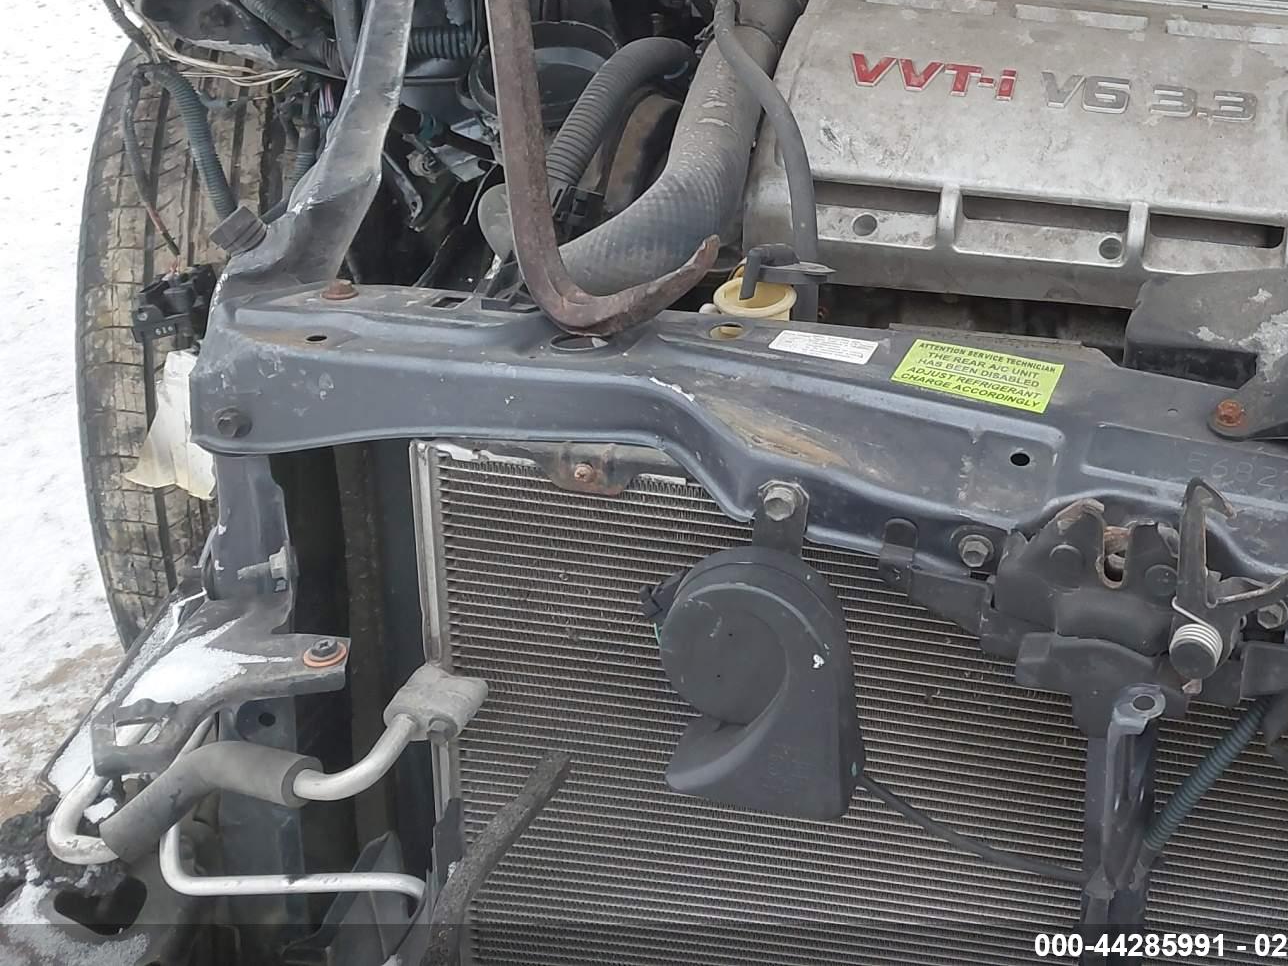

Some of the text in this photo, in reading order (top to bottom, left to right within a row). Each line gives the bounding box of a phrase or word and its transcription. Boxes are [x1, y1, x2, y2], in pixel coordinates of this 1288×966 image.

[851, 51, 1018, 101] VVT-i
[1041, 70, 1258, 122] V6 3.3
[918, 342, 1056, 373] ATTENTION SERVICE TECHNICIAN
[918, 358, 1040, 388] HAS BEEN DISABLED
[927, 352, 1039, 378] THE REAR A/C UNIT
[900, 373, 1041, 408] CHARGE ACCORDINGLY
[906, 366, 1042, 399] ADJUST REFRIGERANT
